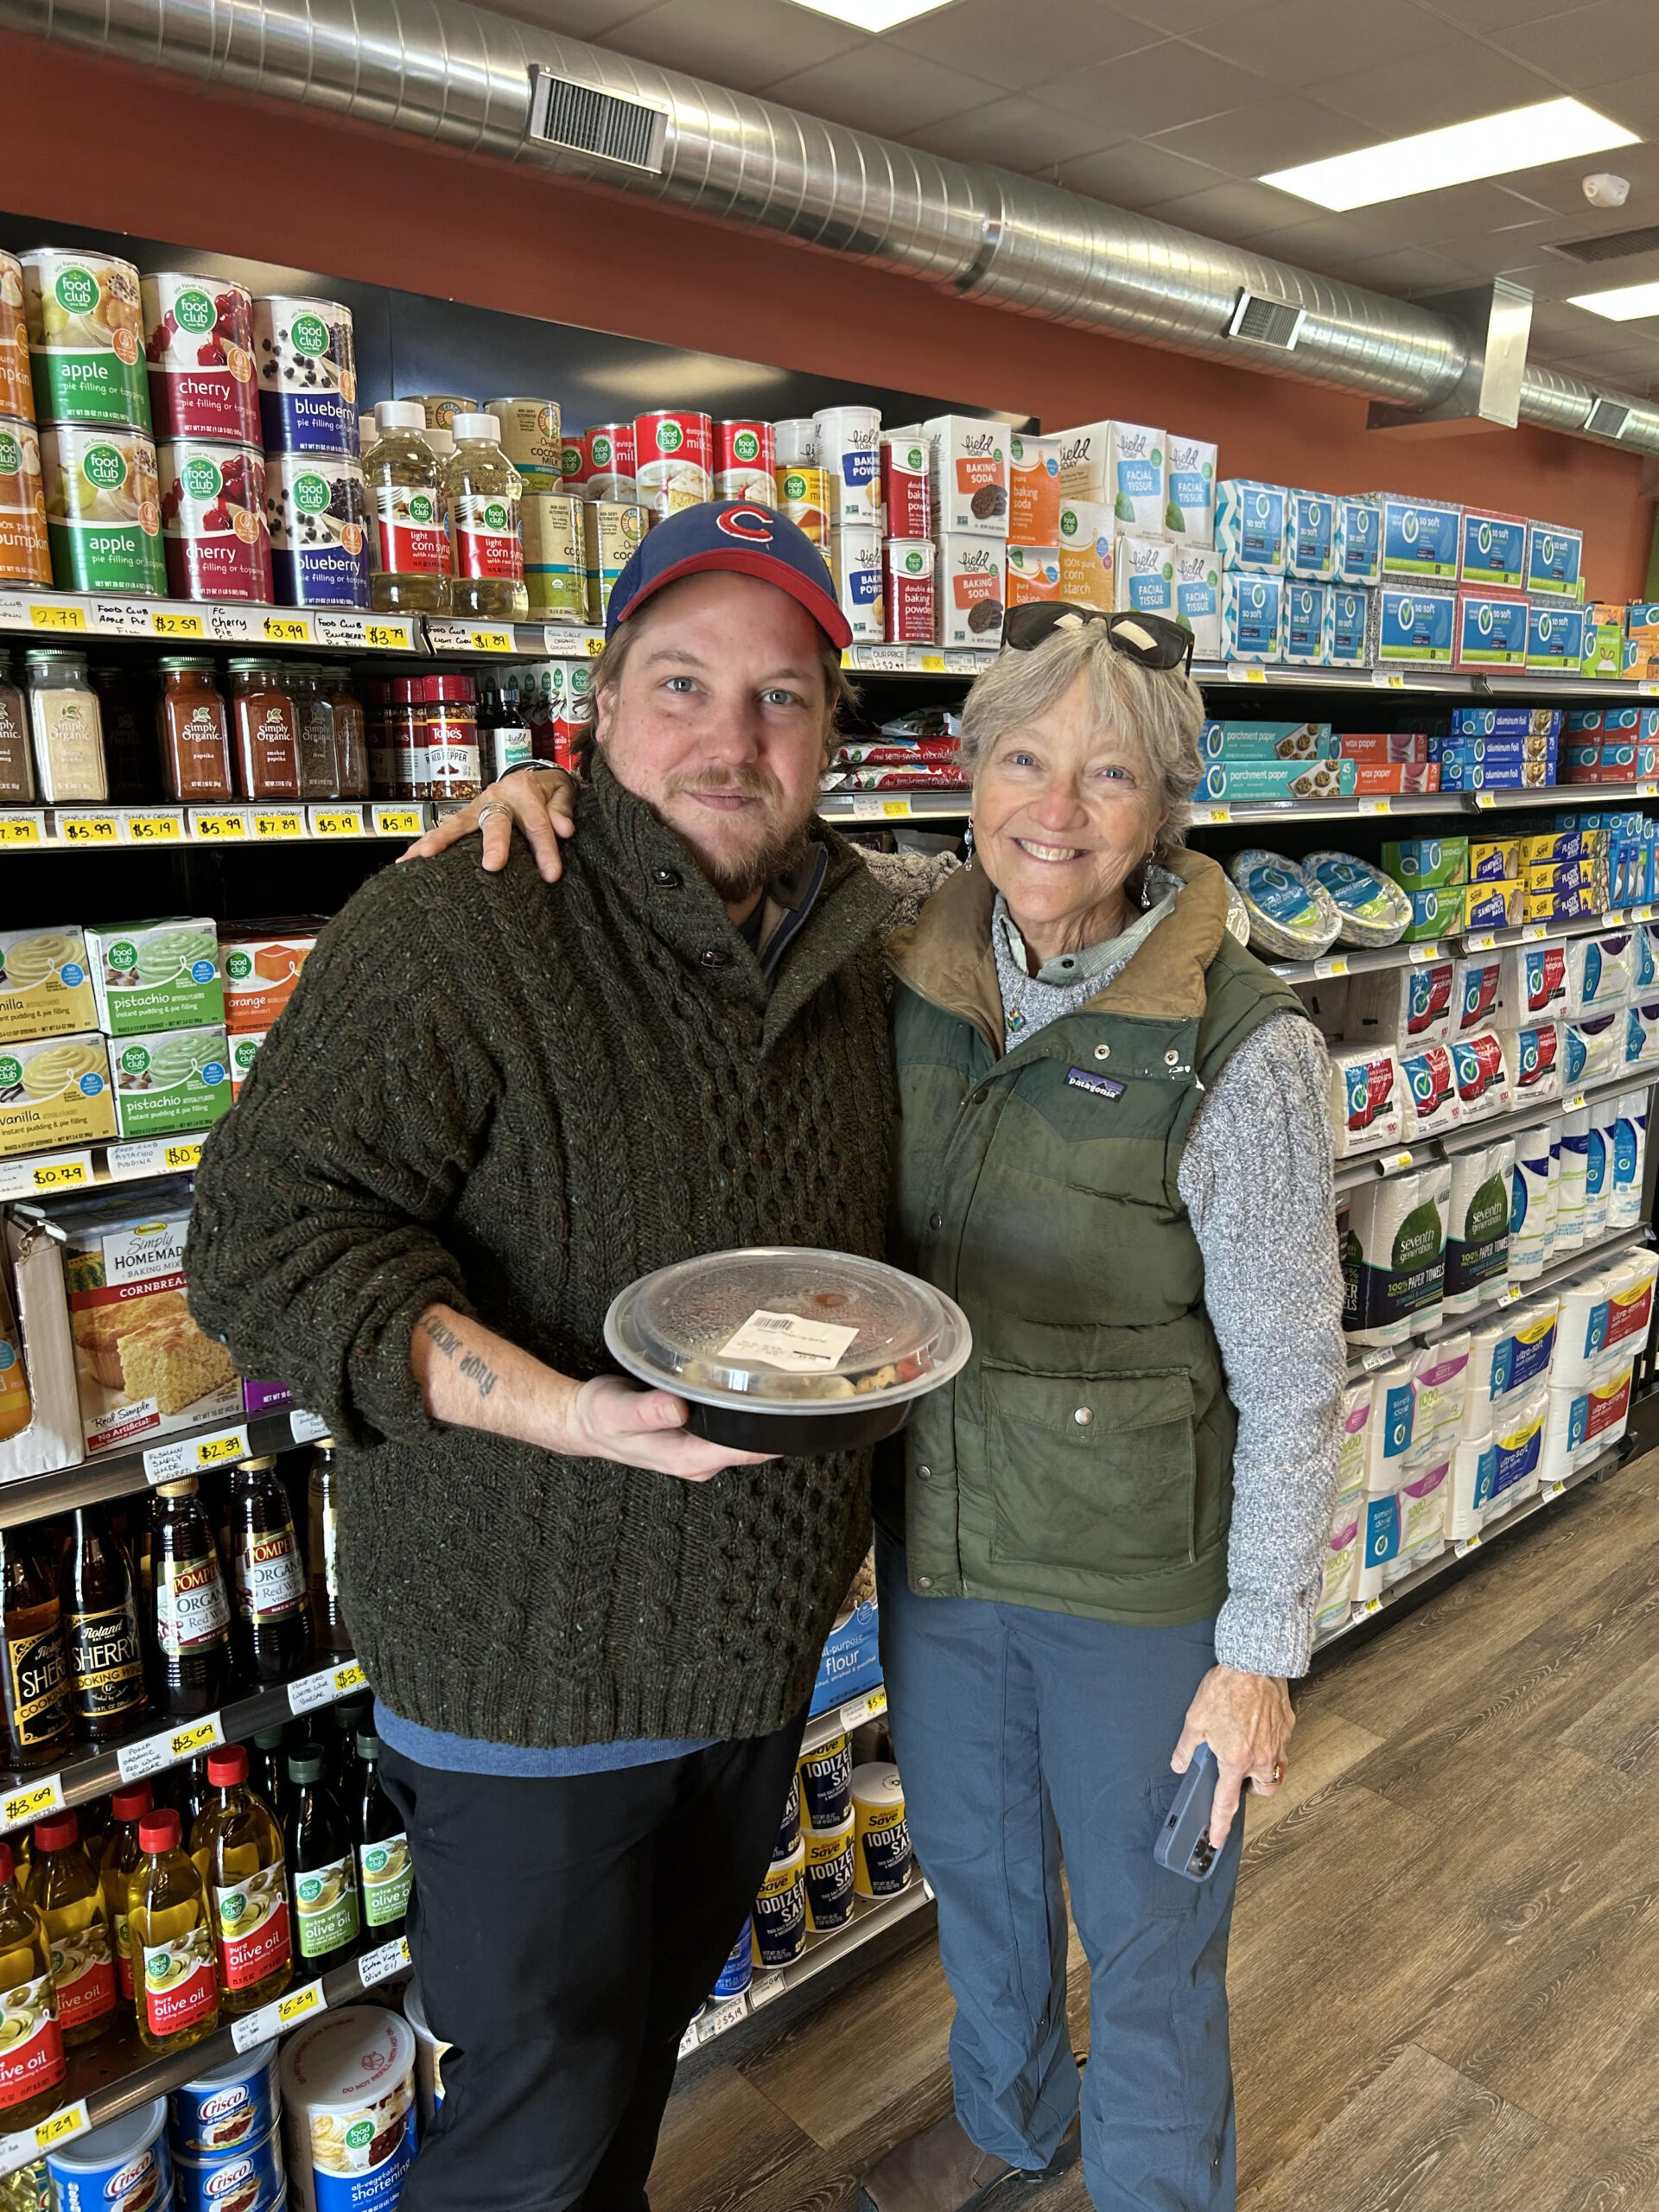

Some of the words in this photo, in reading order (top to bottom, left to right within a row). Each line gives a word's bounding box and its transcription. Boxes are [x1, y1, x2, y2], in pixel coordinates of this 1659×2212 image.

[62, 277, 91, 291] food
[65, 289, 91, 303] club
[181, 299, 208, 312] food
[183, 311, 208, 323] club
[296, 323, 322, 336] food
[299, 335, 322, 347] club
[61, 362, 109, 381] apple
[179, 378, 231, 401] cherry
[295, 398, 355, 424] blueberry
[961, 434, 994, 453] field
[90, 455, 118, 467] food
[965, 462, 996, 473] BAKING
[92, 467, 118, 479] club
[970, 474, 994, 483] SODA
[1014, 475, 1027, 484] pure
[1126, 470, 1153, 480] FACIAL
[297, 482, 322, 494] food
[1127, 480, 1153, 491] TISSUE
[1178, 483, 1204, 493] FACIAL
[1013, 486, 1039, 501] baking
[1179, 493, 1204, 503] TISSUE
[1013, 498, 1032, 510] soda
[715, 504, 774, 543] C
[1427, 518, 1440, 527] soft
[410, 531, 429, 542] light
[485, 538, 502, 548] light
[89, 536, 136, 554] apple
[411, 542, 435, 551] corn
[486, 548, 508, 557] corn
[186, 543, 236, 563] cherry
[958, 550, 989, 569] field
[92, 556, 105, 567] pie
[108, 555, 133, 567] filling
[202, 563, 227, 575] filling
[1064, 569, 1084, 580] corn
[312, 574, 335, 585] filling
[963, 578, 993, 589] BAKING
[968, 588, 990, 598] SODA
[1064, 582, 1090, 594] starch
[1138, 585, 1164, 594] FACIAL
[1139, 595, 1164, 605] TISSUE
[1185, 593, 1209, 602] FACIAL
[1185, 602, 1210, 612] TISSUE
[1422, 605, 1435, 614] soft
[156, 616, 198, 632] $2.59
[211, 618, 248, 631] Cherry
[263, 617, 303, 639] $3.99
[370, 627, 404, 645] $3.79
[474, 633, 505, 650] $1.89
[1496, 715, 1518, 725] aluminum
[184, 722, 217, 734] Simply
[259, 724, 289, 734] Simply
[1227, 731, 1257, 741] parchment
[1259, 732, 1276, 742] paper
[1358, 739, 1376, 748] paper
[1486, 743, 1511, 753] aluminum
[885, 751, 922, 761] semi-sweet
[1230, 770, 1268, 782] parchment
[1268, 769, 1288, 780] paper
[1343, 763, 1351, 773] 45
[1361, 768, 1373, 778] wax
[1373, 767, 1392, 779] paper
[1431, 764, 1439, 774] 75
[1485, 769, 1510, 779] aluminum
[132, 823, 171, 837] $5.19
[200, 819, 241, 834] $5.99
[258, 820, 296, 833] $7.89
[318, 817, 353, 832] $5.19
[382, 816, 413, 830] $5.19
[67, 823, 112, 839] $5.99
[1481, 859, 1503, 874] SANDWICH
[1561, 868, 1580, 883] PLASTIC
[1478, 900, 1503, 917] SANDWICH
[1561, 895, 1579, 912] PLASTIC
[113, 993, 170, 1011] pistachio
[228, 995, 266, 1009] orange
[116, 1008, 137, 1019] instant
[139, 1006, 163, 1017] pudding
[1069, 1077, 1116, 1099] patagonia
[126, 1096, 181, 1113] pistachio
[0, 1110, 41, 1125] vanilla
[128, 1111, 149, 1122] instant
[150, 1108, 175, 1119] pudding
[26, 1122, 52, 1134] pudding
[34, 1167, 82, 1185] $0.79
[1471, 1202, 1503, 1224] seventh
[1471, 1213, 1502, 1235] generation
[128, 1231, 173, 1255] Simply
[1400, 1228, 1434, 1253] seventh
[1400, 1241, 1434, 1263] generation
[1460, 1249, 1479, 1263] 100%
[128, 1264, 162, 1278] BAKING
[164, 1261, 181, 1272] MIX
[1388, 1278, 1408, 1293] 100%
[1408, 1270, 1426, 1289] PAPER
[1426, 1262, 1446, 1284] TOWELS
[1612, 1300, 1647, 1323] ultra-strong
[1515, 1340, 1544, 1362] ultra-soft
[1419, 1388, 1439, 1408] 1000
[1592, 1389, 1626, 1416] ultra-strong
[92, 1415, 116, 1428] Real
[118, 1401, 150, 1418] Simple
[99, 1432, 111, 1442] No
[112, 1418, 151, 1438] Artificial:
[200, 1438, 240, 1459] $2.39
[1407, 1497, 1426, 1516] 1000
[263, 1585, 283, 1599] Red
[188, 1612, 209, 1628] Red
[81, 1619, 124, 1639] Roland
[73, 1636, 138, 1671] SHERRY
[825, 1649, 860, 1675] flour
[74, 1670, 120, 1689] COOKING
[868, 1814, 899, 1828] Save
[810, 1842, 841, 1859] Save
[821, 1839, 841, 1850] Always
[372, 1888, 391, 1897] extra
[756, 1876, 805, 1915] IODIZED
[372, 1892, 401, 1909] olive
[305, 1917, 325, 1928] extra
[327, 1910, 346, 1923] virgin
[305, 1923, 335, 1940] olive
[338, 1914, 352, 1929] oil
[230, 1947, 262, 1966] olive
[264, 1931, 280, 1951] oil
[155, 1998, 187, 2017] olive
[190, 1987, 205, 2003] oil
[277, 1991, 314, 2016] $6.29
[28, 2050, 47, 2071] oil
[355, 2082, 367, 2091] NOT
[202, 2088, 243, 2120] Crisco
[35, 2114, 73, 2140] $4.29
[111, 2155, 149, 2196] Crisco
[209, 2161, 248, 2195] Crisco
[351, 2161, 402, 2191] all-vegetable
[352, 2158, 410, 2202] shortening
